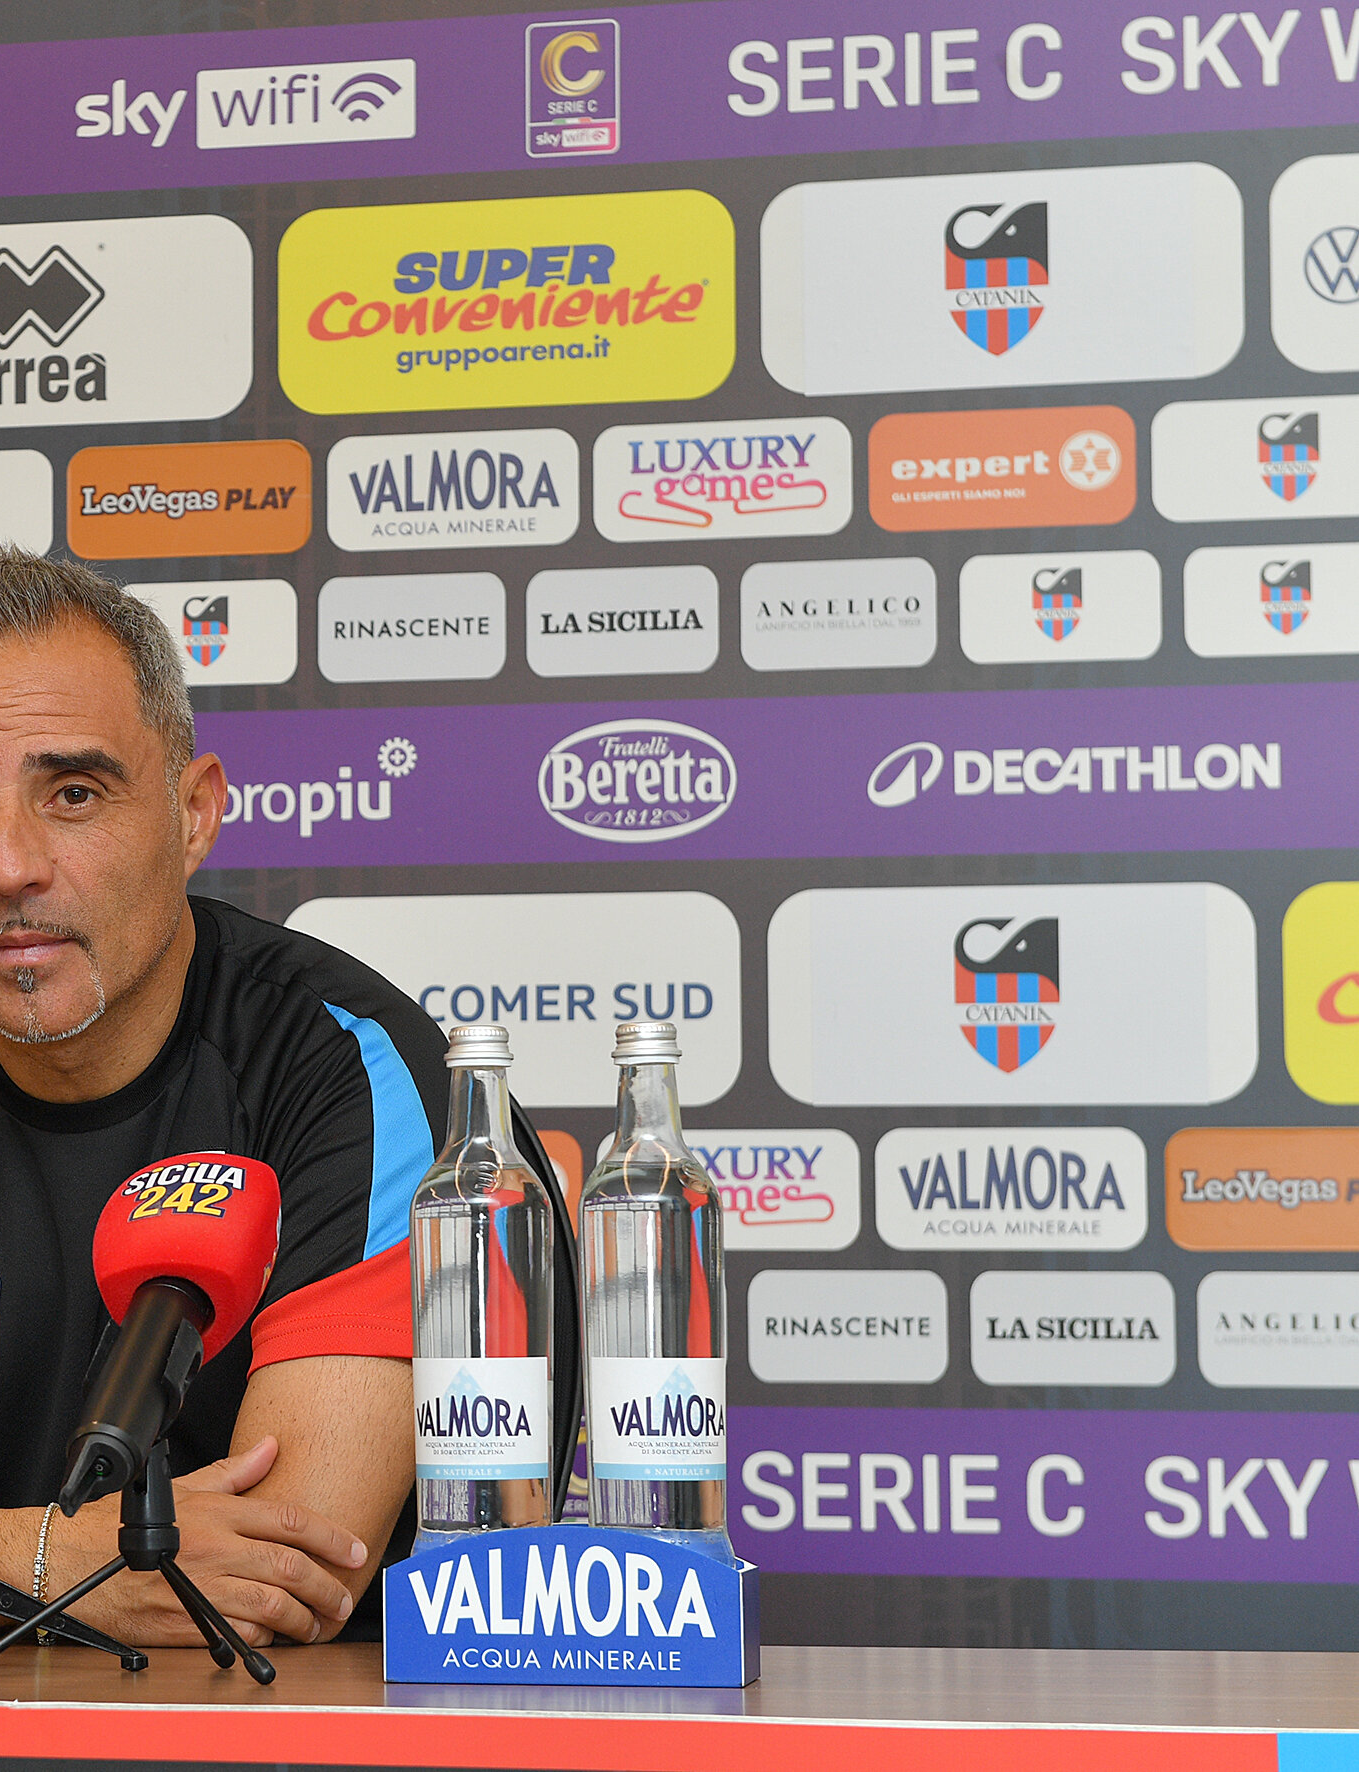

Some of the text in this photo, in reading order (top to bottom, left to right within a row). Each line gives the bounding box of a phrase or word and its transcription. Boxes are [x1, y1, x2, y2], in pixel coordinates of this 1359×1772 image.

[727, 28, 981, 117] SERIE
[1004, 23, 1063, 102] C
[1120, 9, 1301, 96] SKY
[74, 74, 320, 147] sky wifi
[547, 99, 598, 115] SERIE C
[393, 244, 615, 294] SUPER
[307, 274, 706, 341] Conveniente
[954, 288, 1042, 308] CATANIA
[396, 335, 611, 373] gruppoarena.it
[628, 433, 816, 473] LUXURY
[891, 450, 1050, 483] expert
[349, 448, 561, 515] VALMORA
[81, 483, 297, 519] LeoVegas PLAY
[370, 516, 537, 537] ACQUA MINERALE
[541, 608, 704, 635] LA SICILIA
[757, 596, 921, 617] ANGELICO
[334, 616, 490, 639] RINASCENTE
[598, 736, 670, 760] Fratelli
[549, 750, 727, 812] Beretta
[953, 742, 1282, 795] DECATHLON
[612, 807, 664, 826] 1812
[419, 982, 714, 1022] COMER SUD
[965, 1003, 1053, 1024] CATANIA
[899, 1145, 1126, 1210] VALMORA
[1180, 1169, 1339, 1210] LeoVegas
[132, 1182, 230, 1220] 242
[923, 1218, 1102, 1236] ACQUA MINERALE
[765, 1316, 931, 1337] RINASCENTE
[986, 1316, 1159, 1340] LA SICILIA
[1216, 1311, 1359, 1331] ANGELIC
[416, 1394, 532, 1438] VALMORA
[610, 1394, 725, 1437] VALMORA
[443, 1468, 493, 1476] NATURALE
[741, 1450, 1001, 1534] SERIE
[1026, 1453, 1086, 1538] C
[1144, 1455, 1330, 1540] SKY
[408, 1544, 717, 1639] VALMORA
[442, 1647, 682, 1672] ACQUA MINERALE
